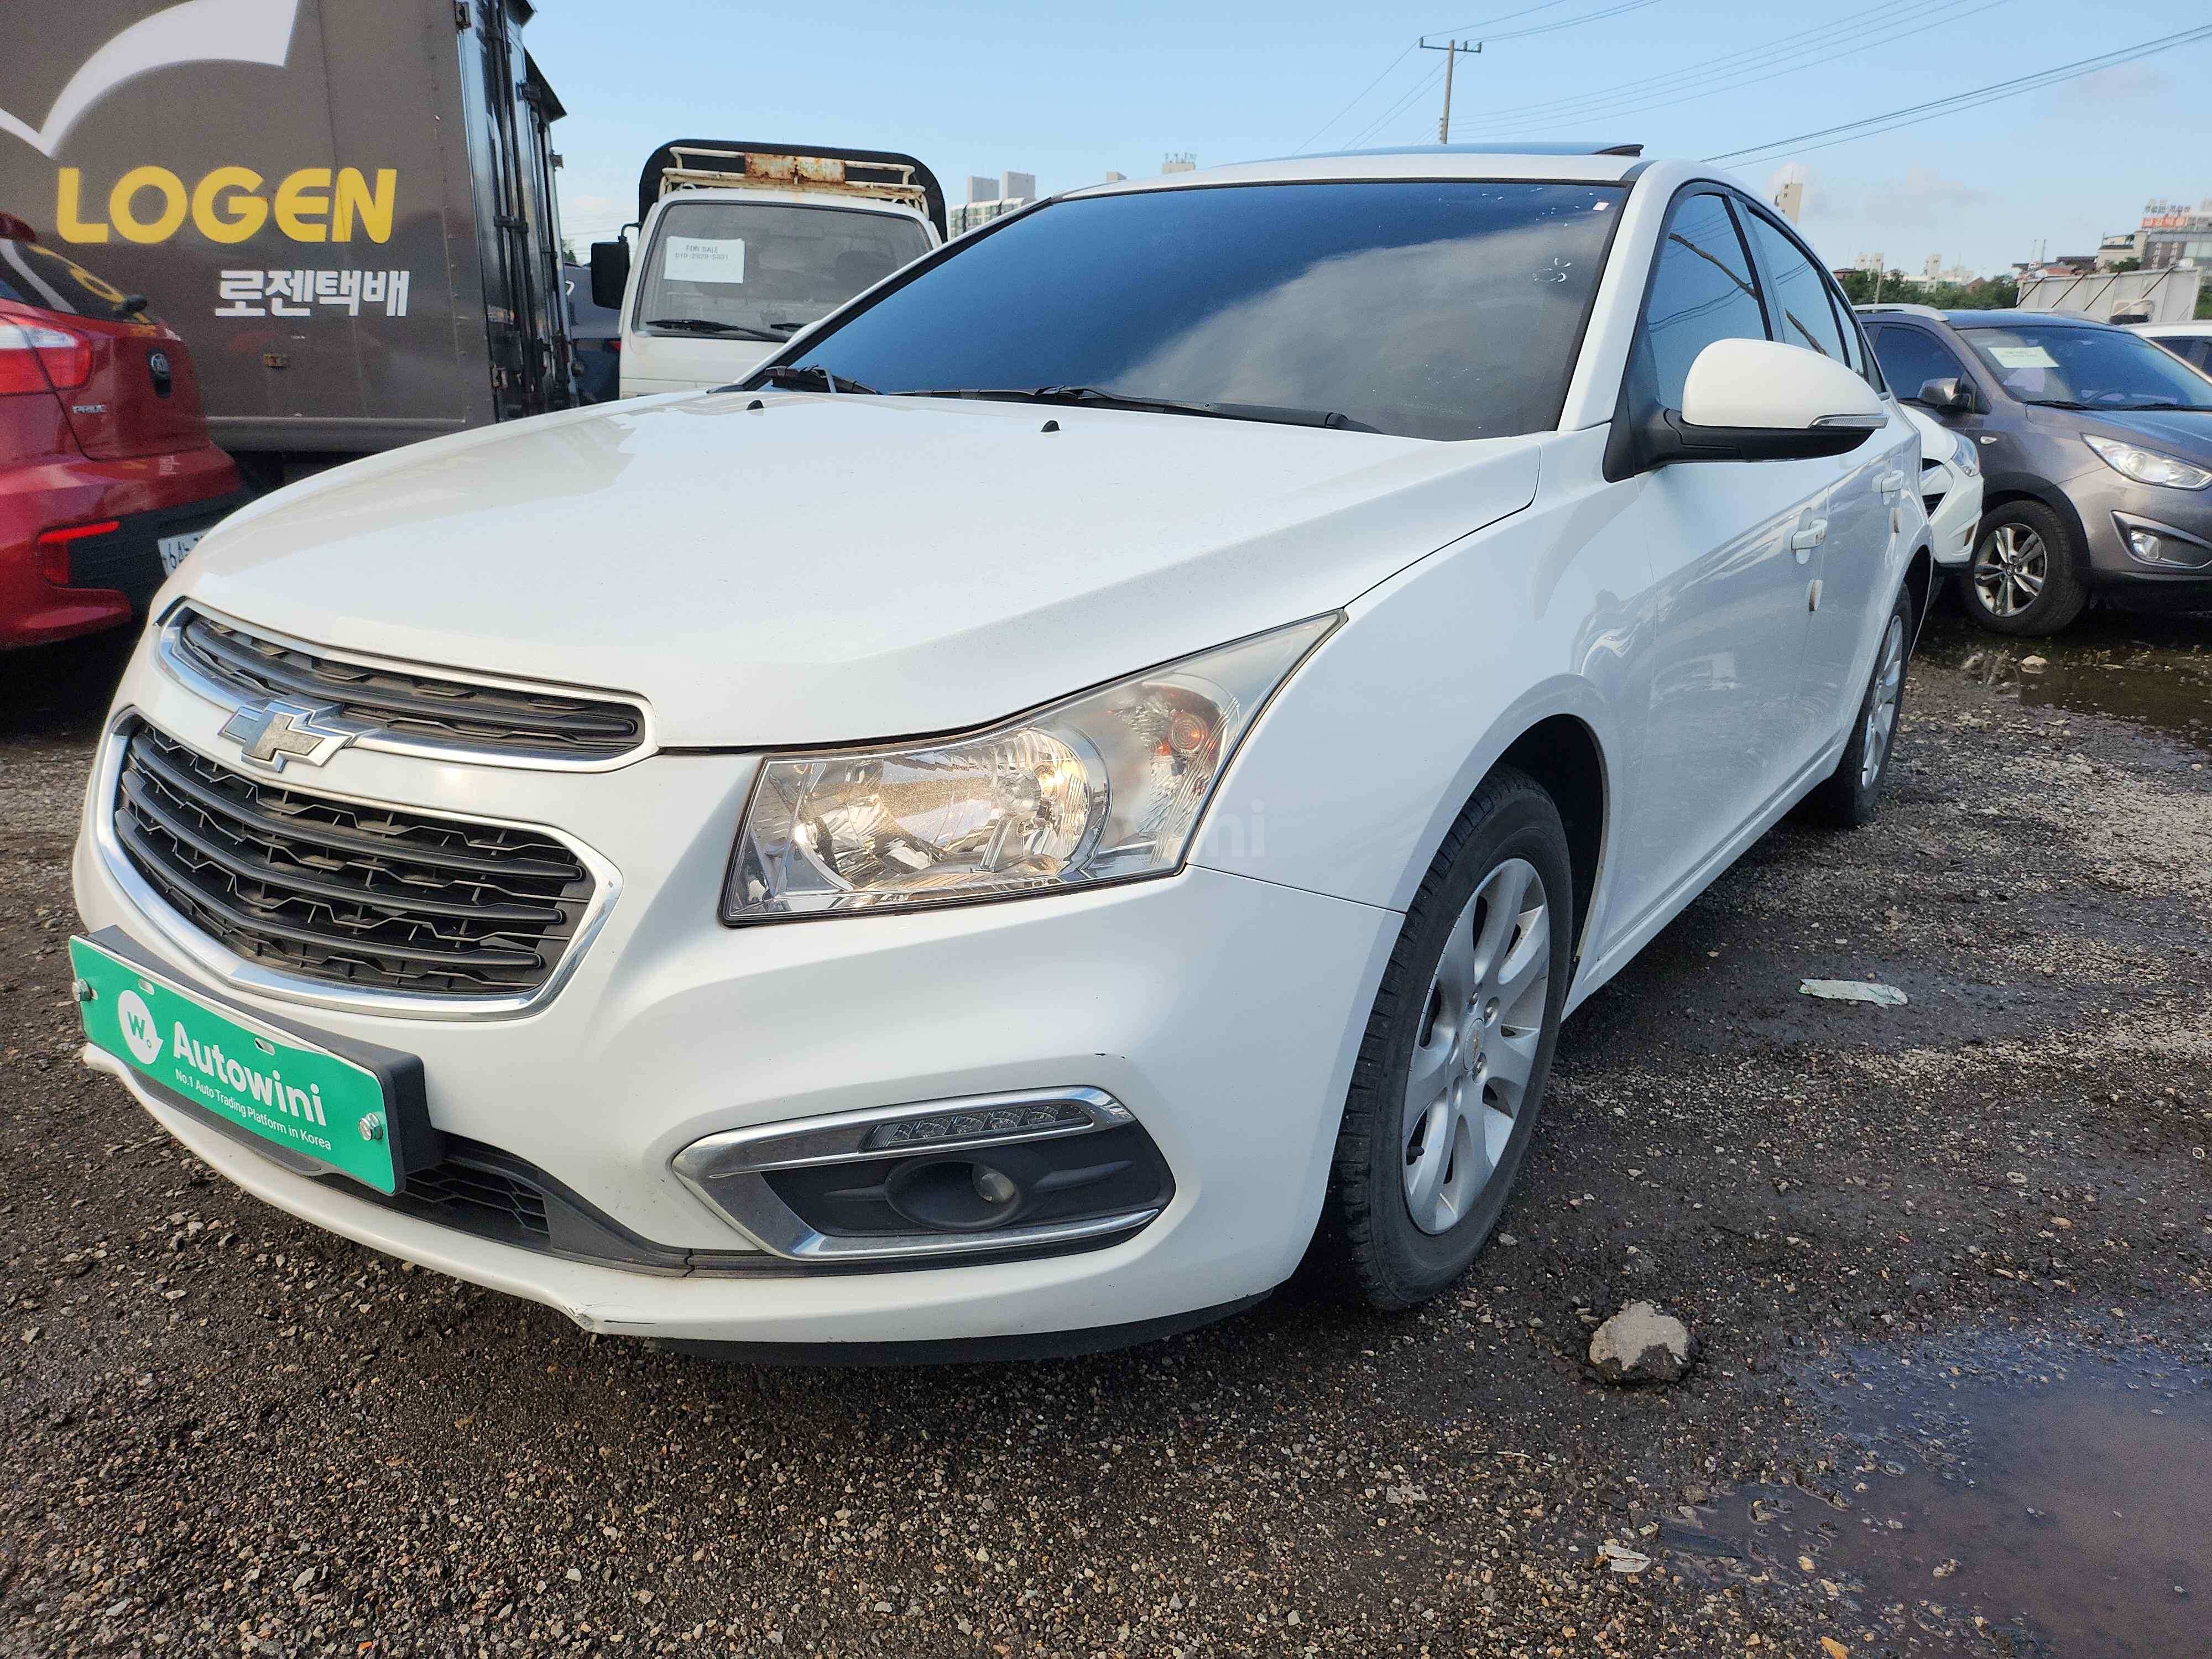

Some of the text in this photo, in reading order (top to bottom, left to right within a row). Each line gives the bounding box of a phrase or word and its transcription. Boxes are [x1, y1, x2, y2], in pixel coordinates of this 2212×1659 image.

[57, 166, 397, 244] LOGEN
[215, 270, 410, 317] 로젠택배
[173, 1021, 327, 1126] Autowini
[175, 1068, 332, 1151] No.1 Auto Trading Platform in Korea
